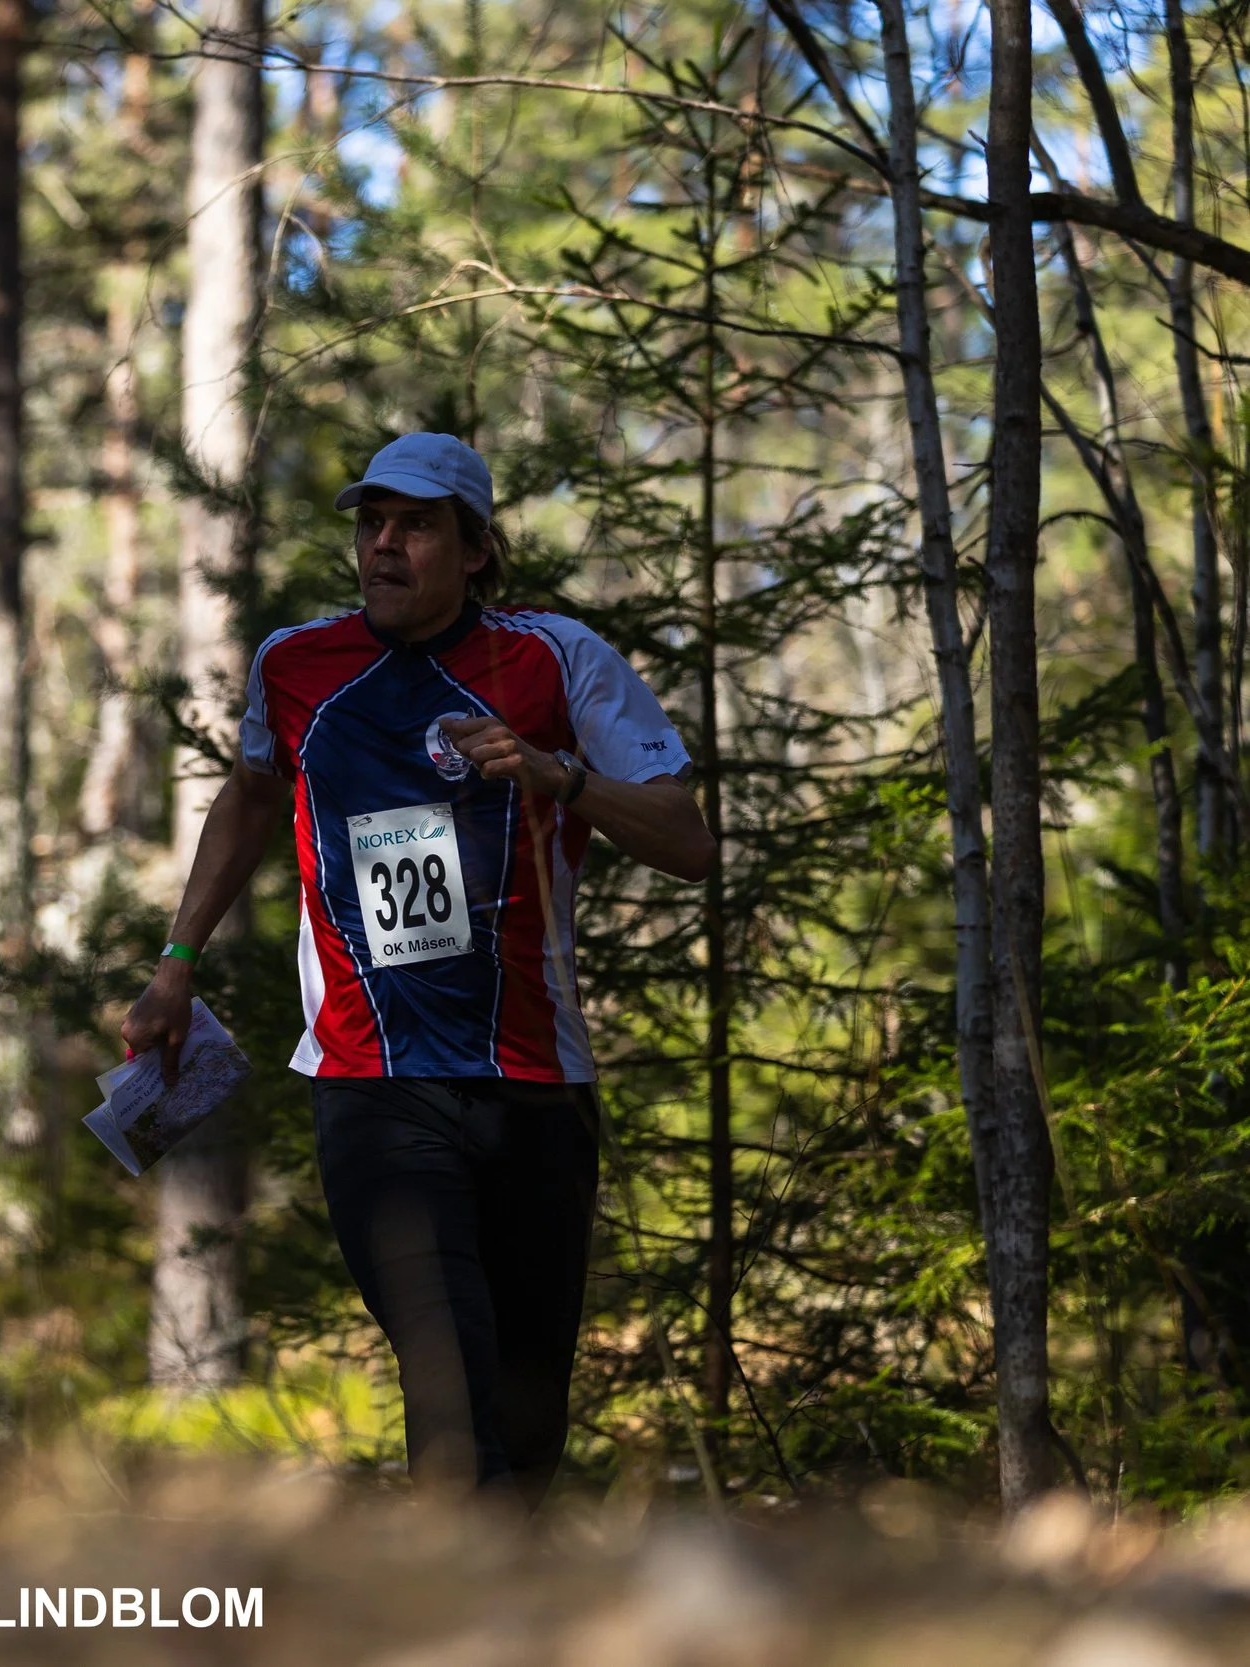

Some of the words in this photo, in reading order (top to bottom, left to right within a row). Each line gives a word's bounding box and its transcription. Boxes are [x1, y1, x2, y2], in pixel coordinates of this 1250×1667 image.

[356, 828, 418, 850] NOREX
[370, 853, 452, 932] 328
[383, 942, 405, 957] OK
[408, 936, 456, 953] Måsen
